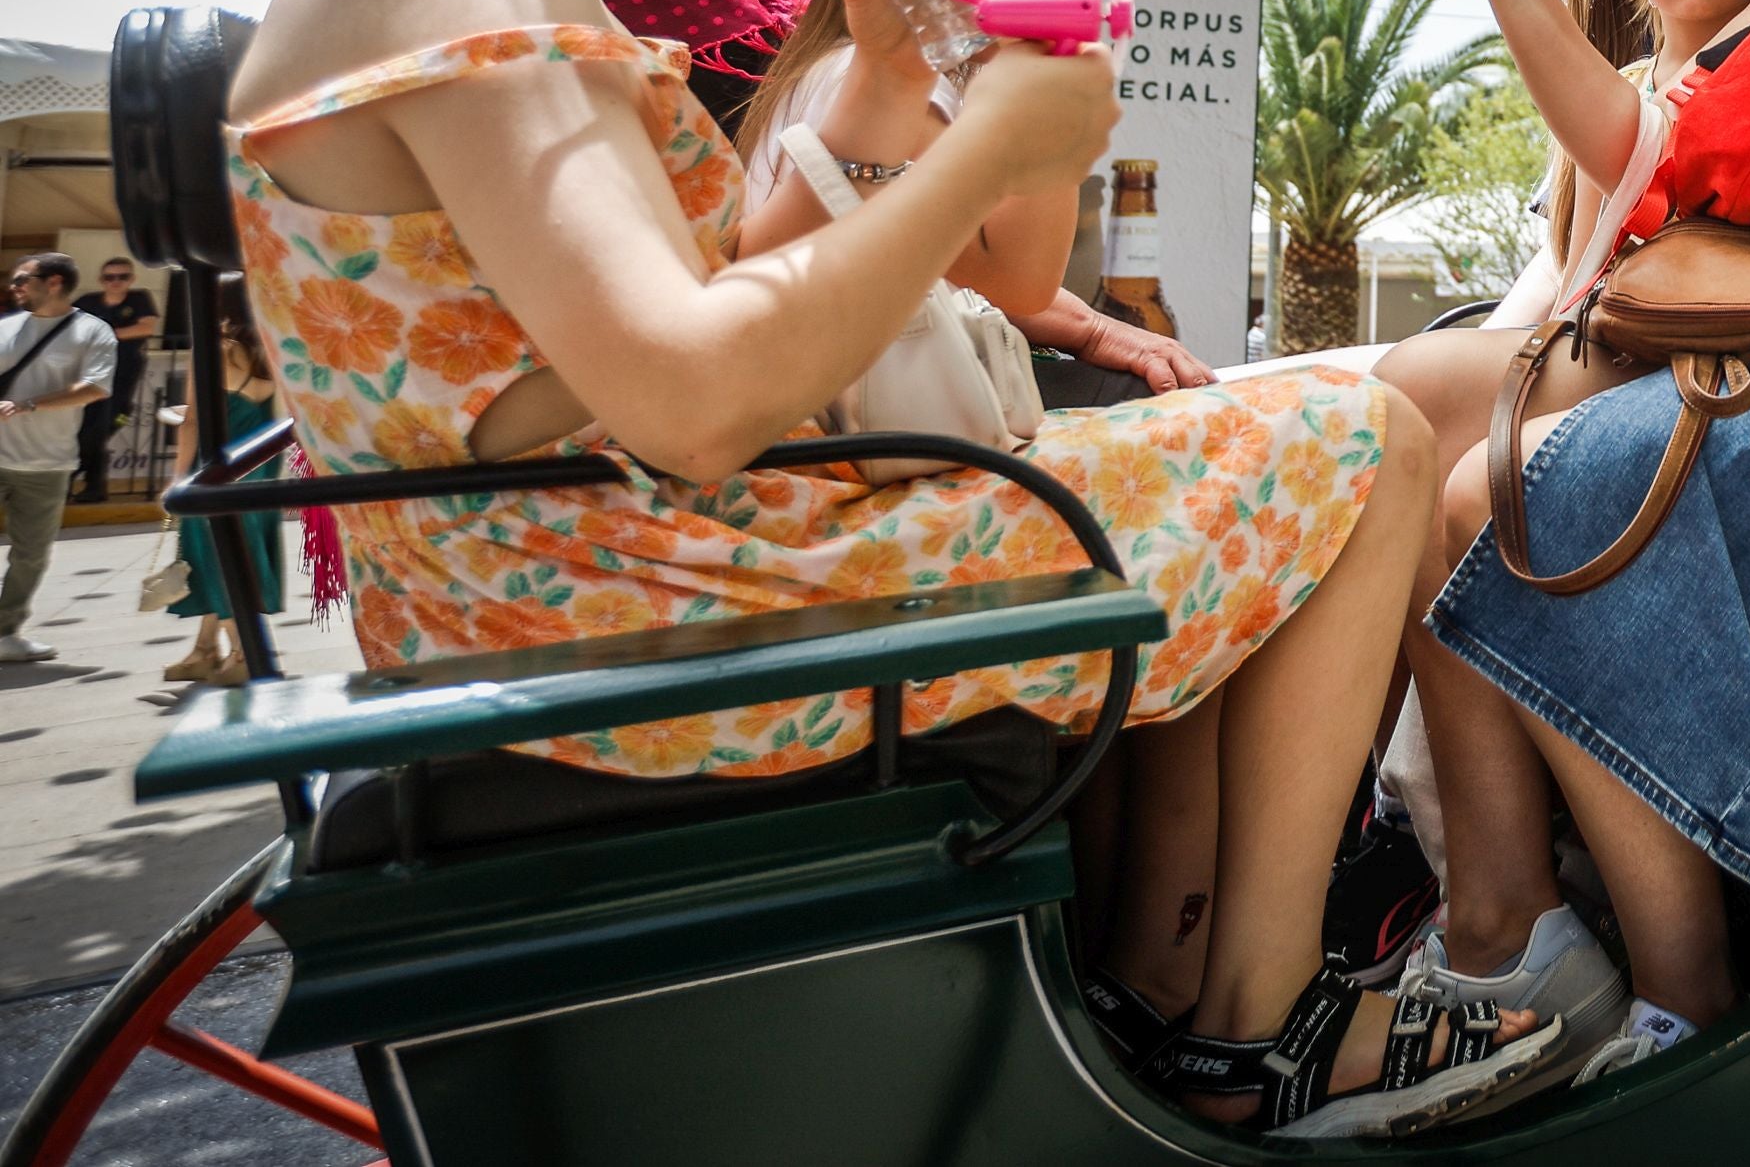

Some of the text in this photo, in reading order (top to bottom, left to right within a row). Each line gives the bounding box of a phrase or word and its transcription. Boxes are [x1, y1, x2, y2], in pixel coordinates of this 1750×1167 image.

[1135, 9, 1243, 34] ORPUS
[1170, 44, 1237, 69] MÁS
[1120, 80, 1231, 104] ECIAL.
